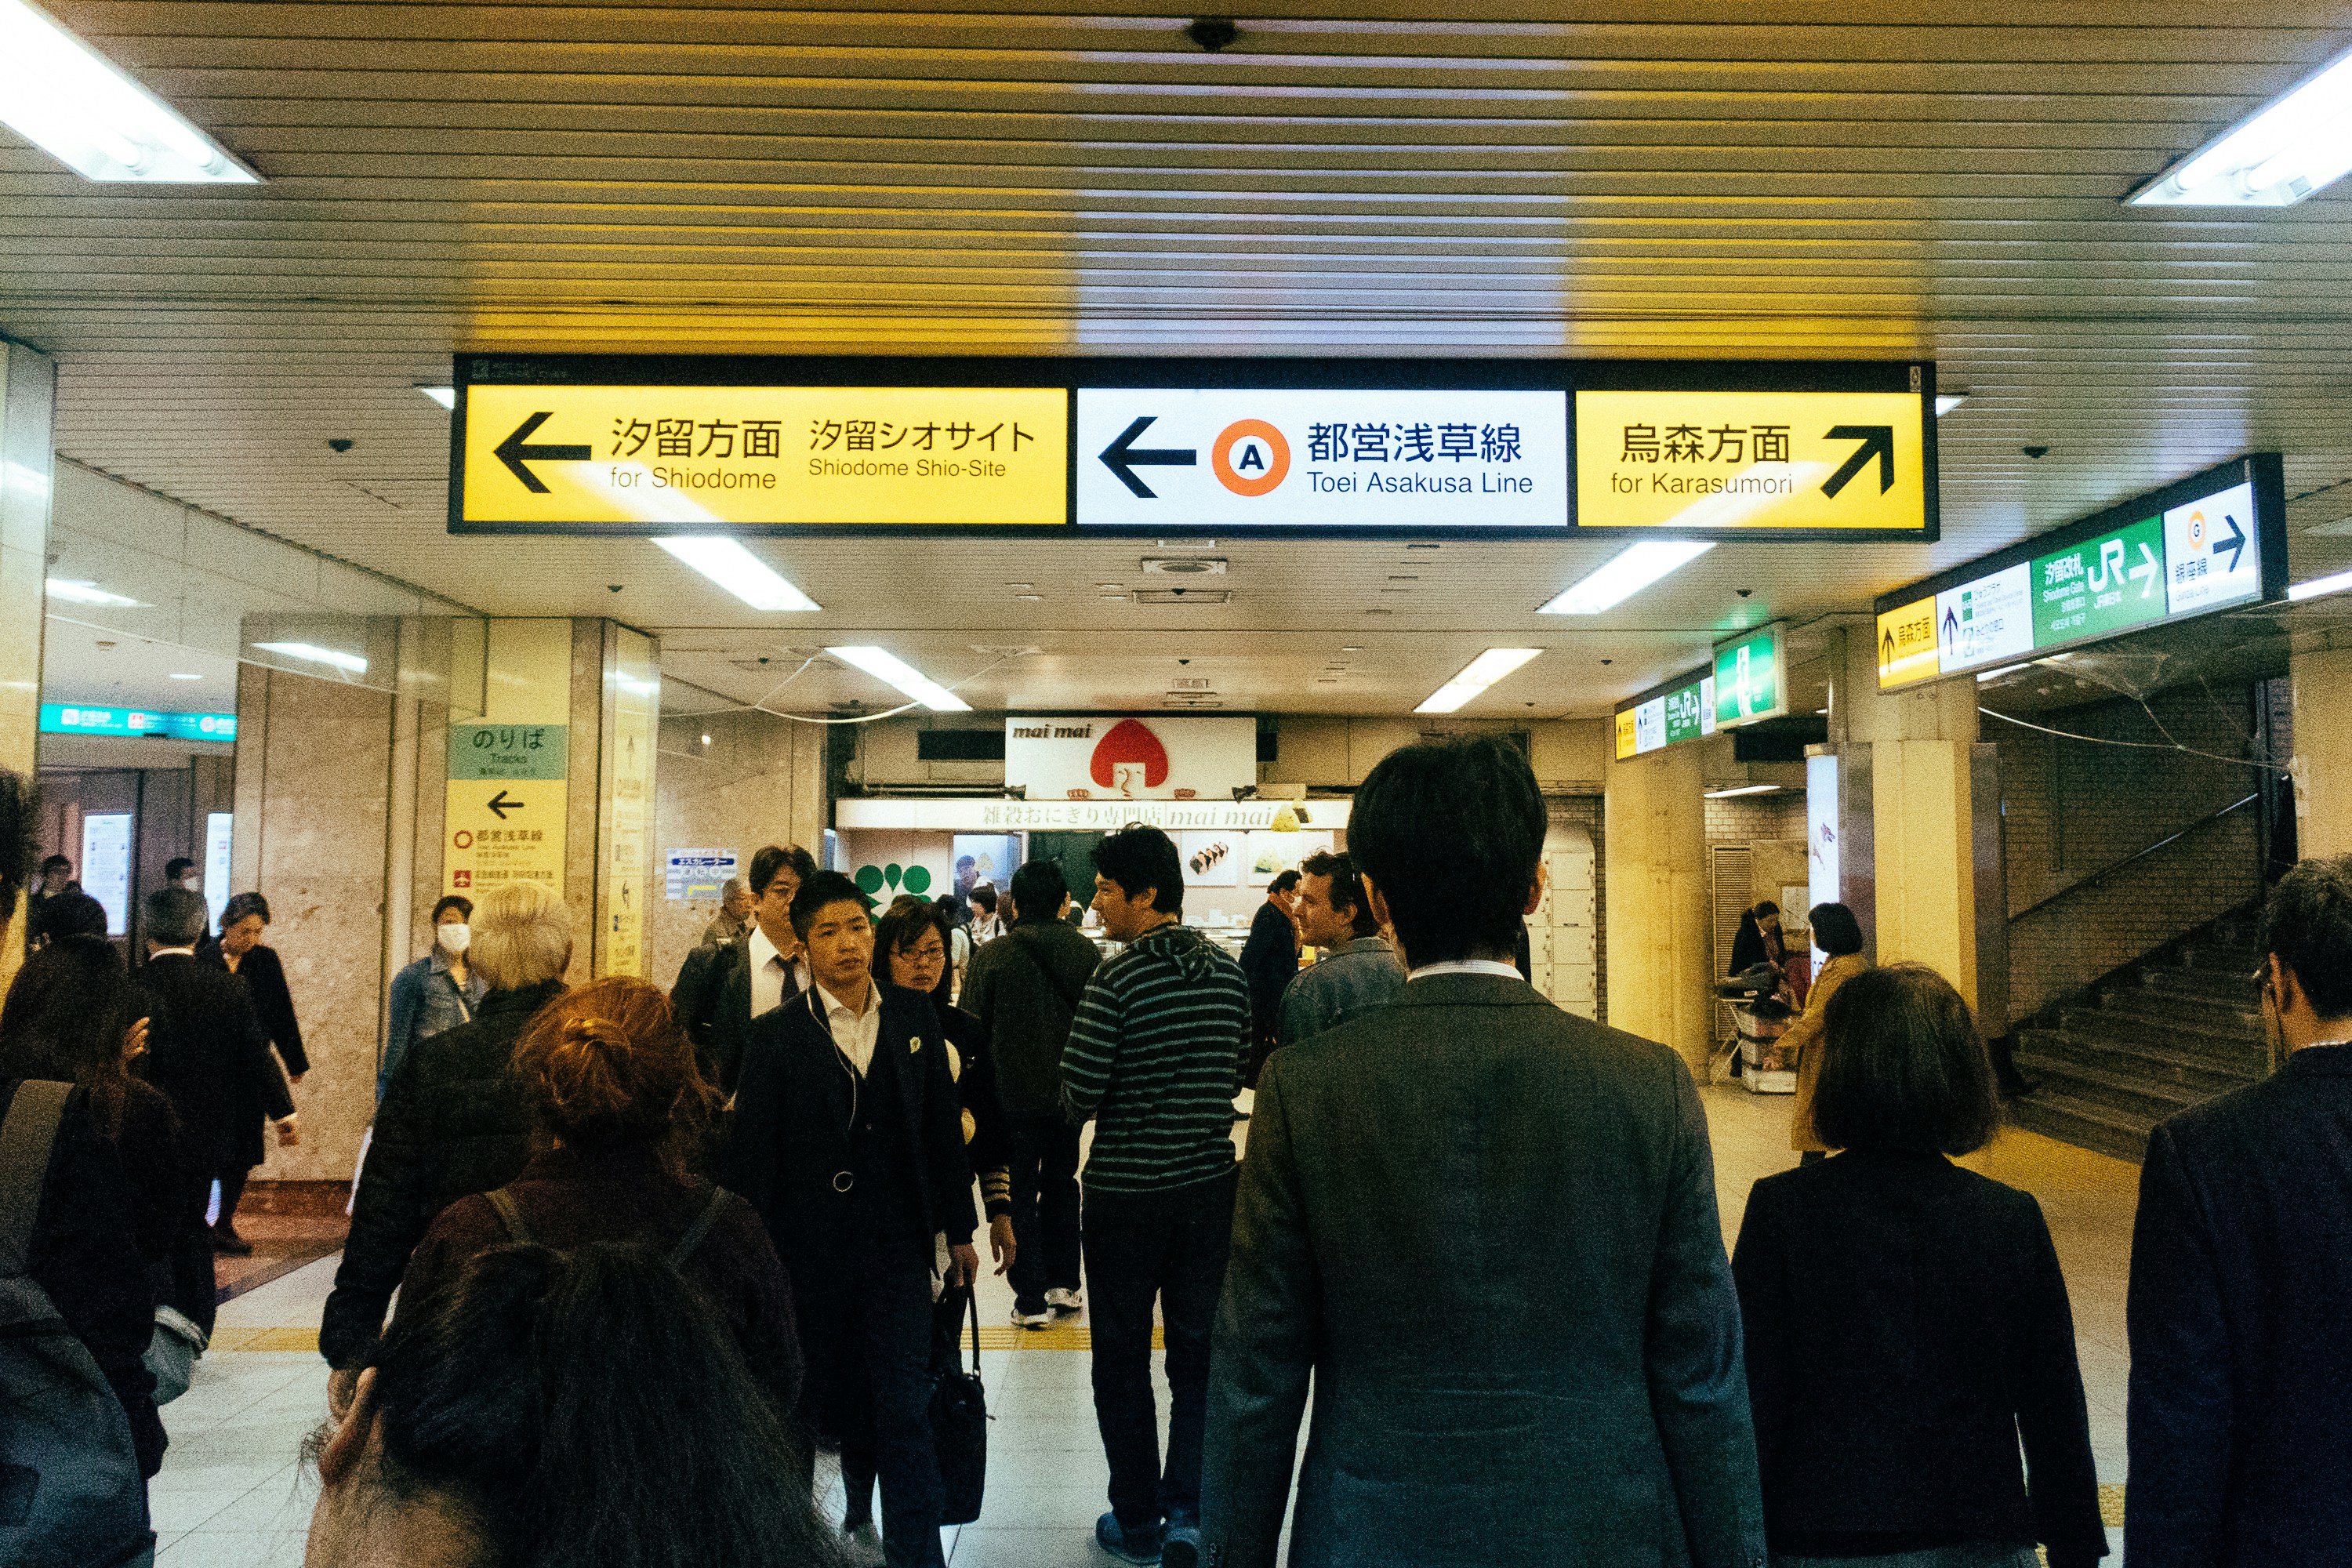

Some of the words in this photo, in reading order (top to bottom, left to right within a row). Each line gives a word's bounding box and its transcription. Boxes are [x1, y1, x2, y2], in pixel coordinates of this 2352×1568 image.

[611, 418, 782, 459] 汐留方面
[809, 419, 1035, 452] 汐留シオサイト
[1307, 422, 1523, 463] 都営浅草線
[1620, 423, 1791, 463] 烏森方面
[808, 458, 909, 477] Shiodome
[916, 459, 1007, 477] Shio-Site
[1239, 445, 1265, 470] A
[610, 466, 642, 488] for
[652, 466, 776, 490] Shiodome
[1306, 471, 1357, 494] Toei
[1367, 471, 1473, 494] Asakusa
[1483, 472, 1534, 495] Line
[1611, 472, 1643, 494] for
[1652, 472, 1793, 495] Karasumori
[2193, 523, 2201, 538] G
[2044, 553, 2084, 586] 汐留改札
[2087, 538, 2125, 593] JR
[2176, 557, 2208, 584] 銀座線
[472, 728, 546, 750] のりば
[1013, 724, 1050, 739] mai
[1054, 724, 1092, 739] mai
[982, 804, 1162, 826] 雑穀おにぎり専門店
[1170, 807, 1218, 826] mai
[1225, 807, 1272, 826] mai
